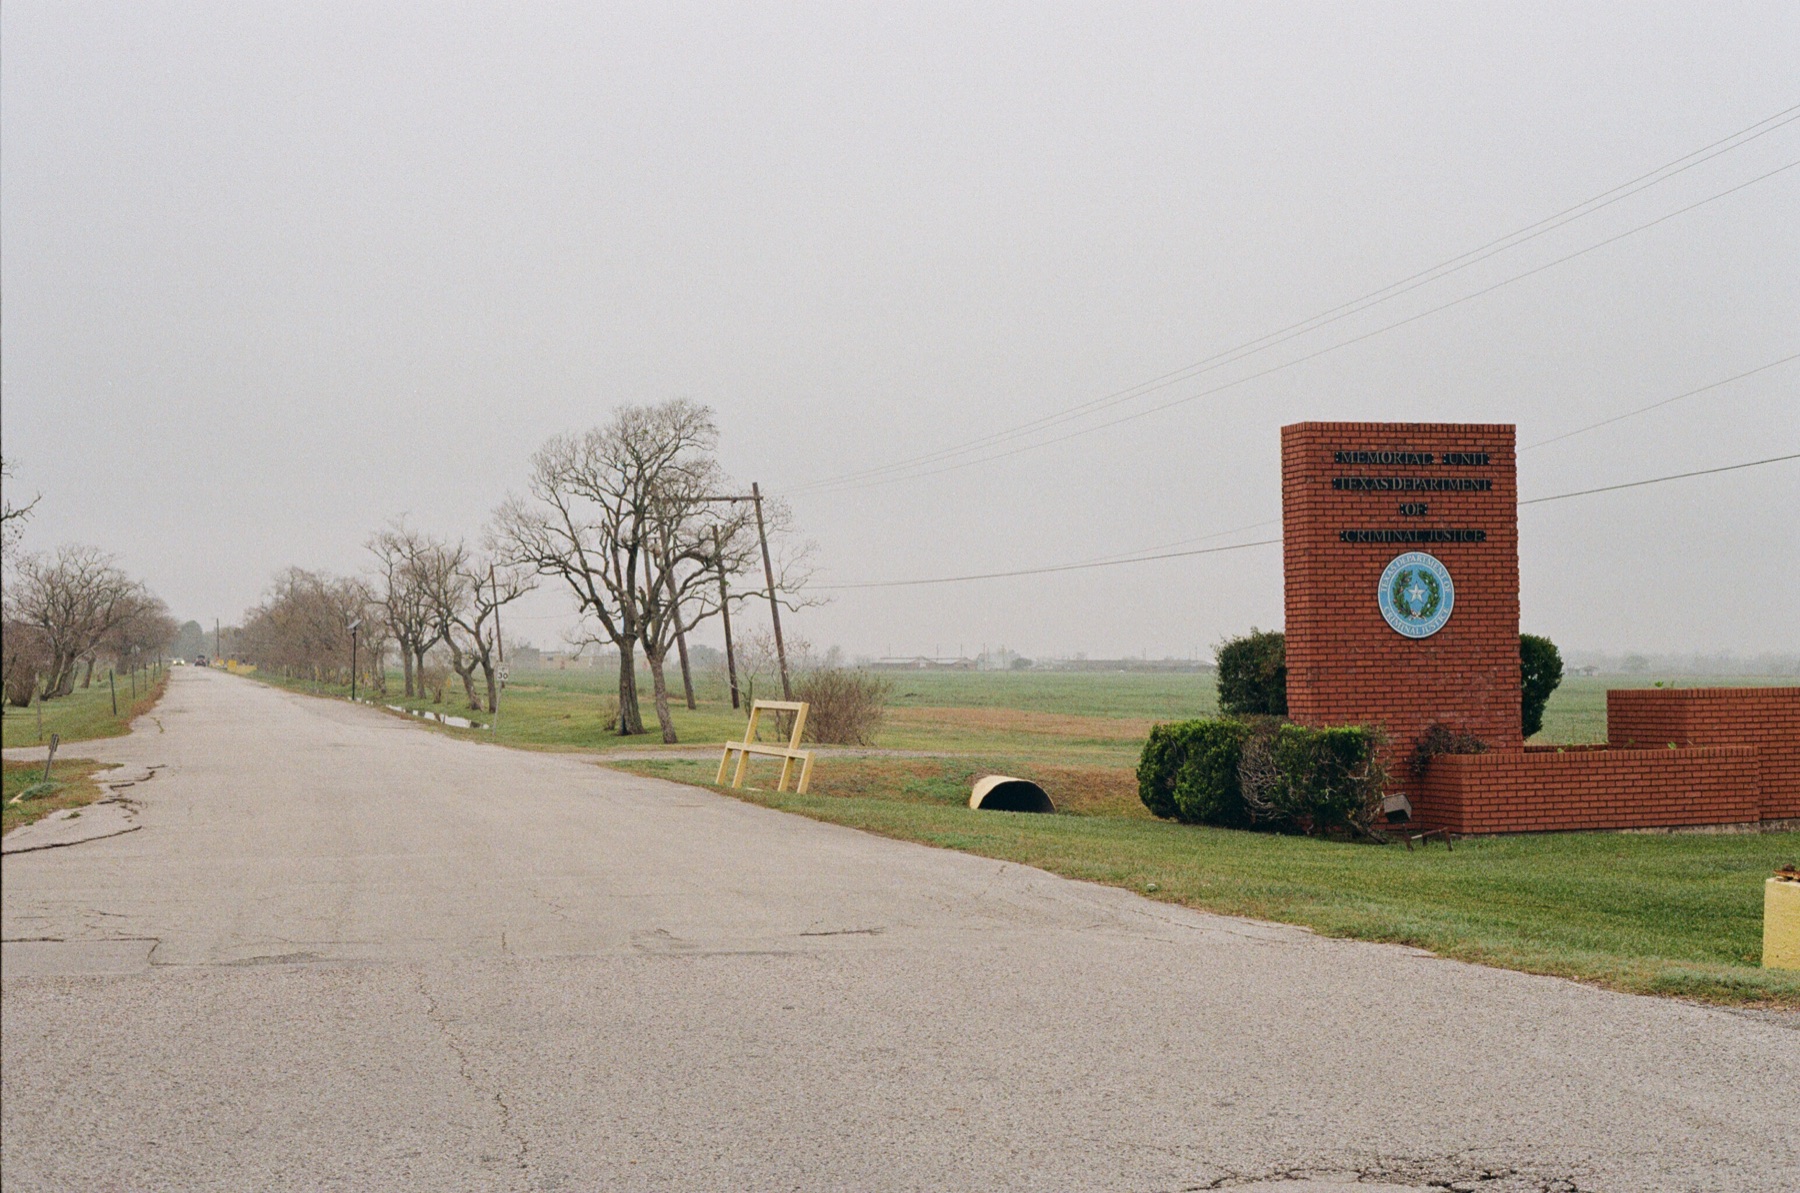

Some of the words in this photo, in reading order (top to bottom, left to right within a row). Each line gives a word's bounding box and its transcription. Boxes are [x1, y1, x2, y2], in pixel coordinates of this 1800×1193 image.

[1341, 451, 1431, 464] MEMORIAL
[1449, 453, 1487, 465] UNIT
[1339, 477, 1388, 490] TEXAS
[1391, 478, 1489, 491] DEPARTMENT
[1404, 503, 1424, 516] OF
[1345, 530, 1423, 542] CRIMINAL
[1428, 530, 1483, 542] JUSTICE
[1381, 566, 1396, 592] TEXAS
[1396, 555, 1447, 579] DEPARTMENT
[1384, 607, 1420, 634] CRIMINAL
[1422, 608, 1449, 634] JUSTICE
